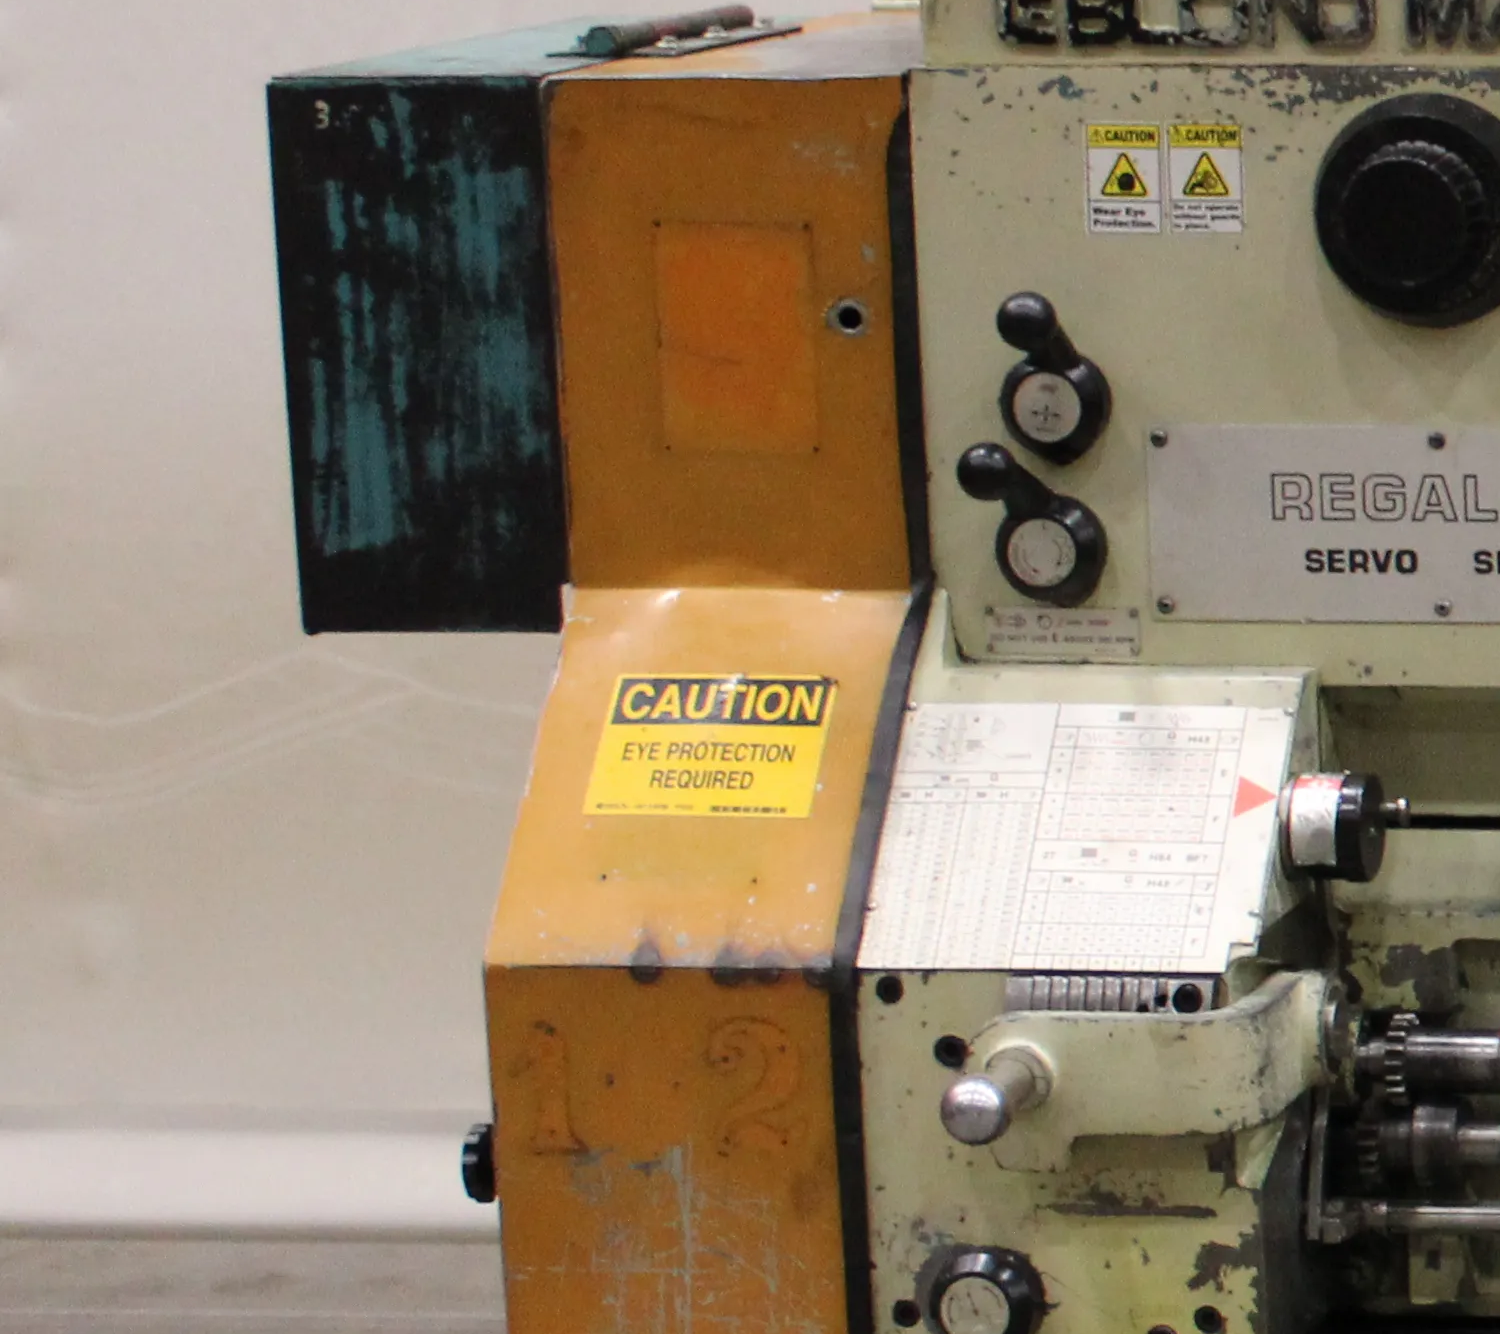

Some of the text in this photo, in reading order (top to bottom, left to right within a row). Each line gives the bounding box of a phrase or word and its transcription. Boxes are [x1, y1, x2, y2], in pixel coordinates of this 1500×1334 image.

[1104, 130, 1155, 143] CAUTION
[1185, 129, 1237, 141] CAUTION
[1270, 473, 1499, 522] REGAL
[1304, 549, 1419, 574] SERVO
[621, 682, 824, 722] CAUTION
[621, 741, 796, 762] EYE PROTECTION
[649, 769, 755, 790] REQUIRED
